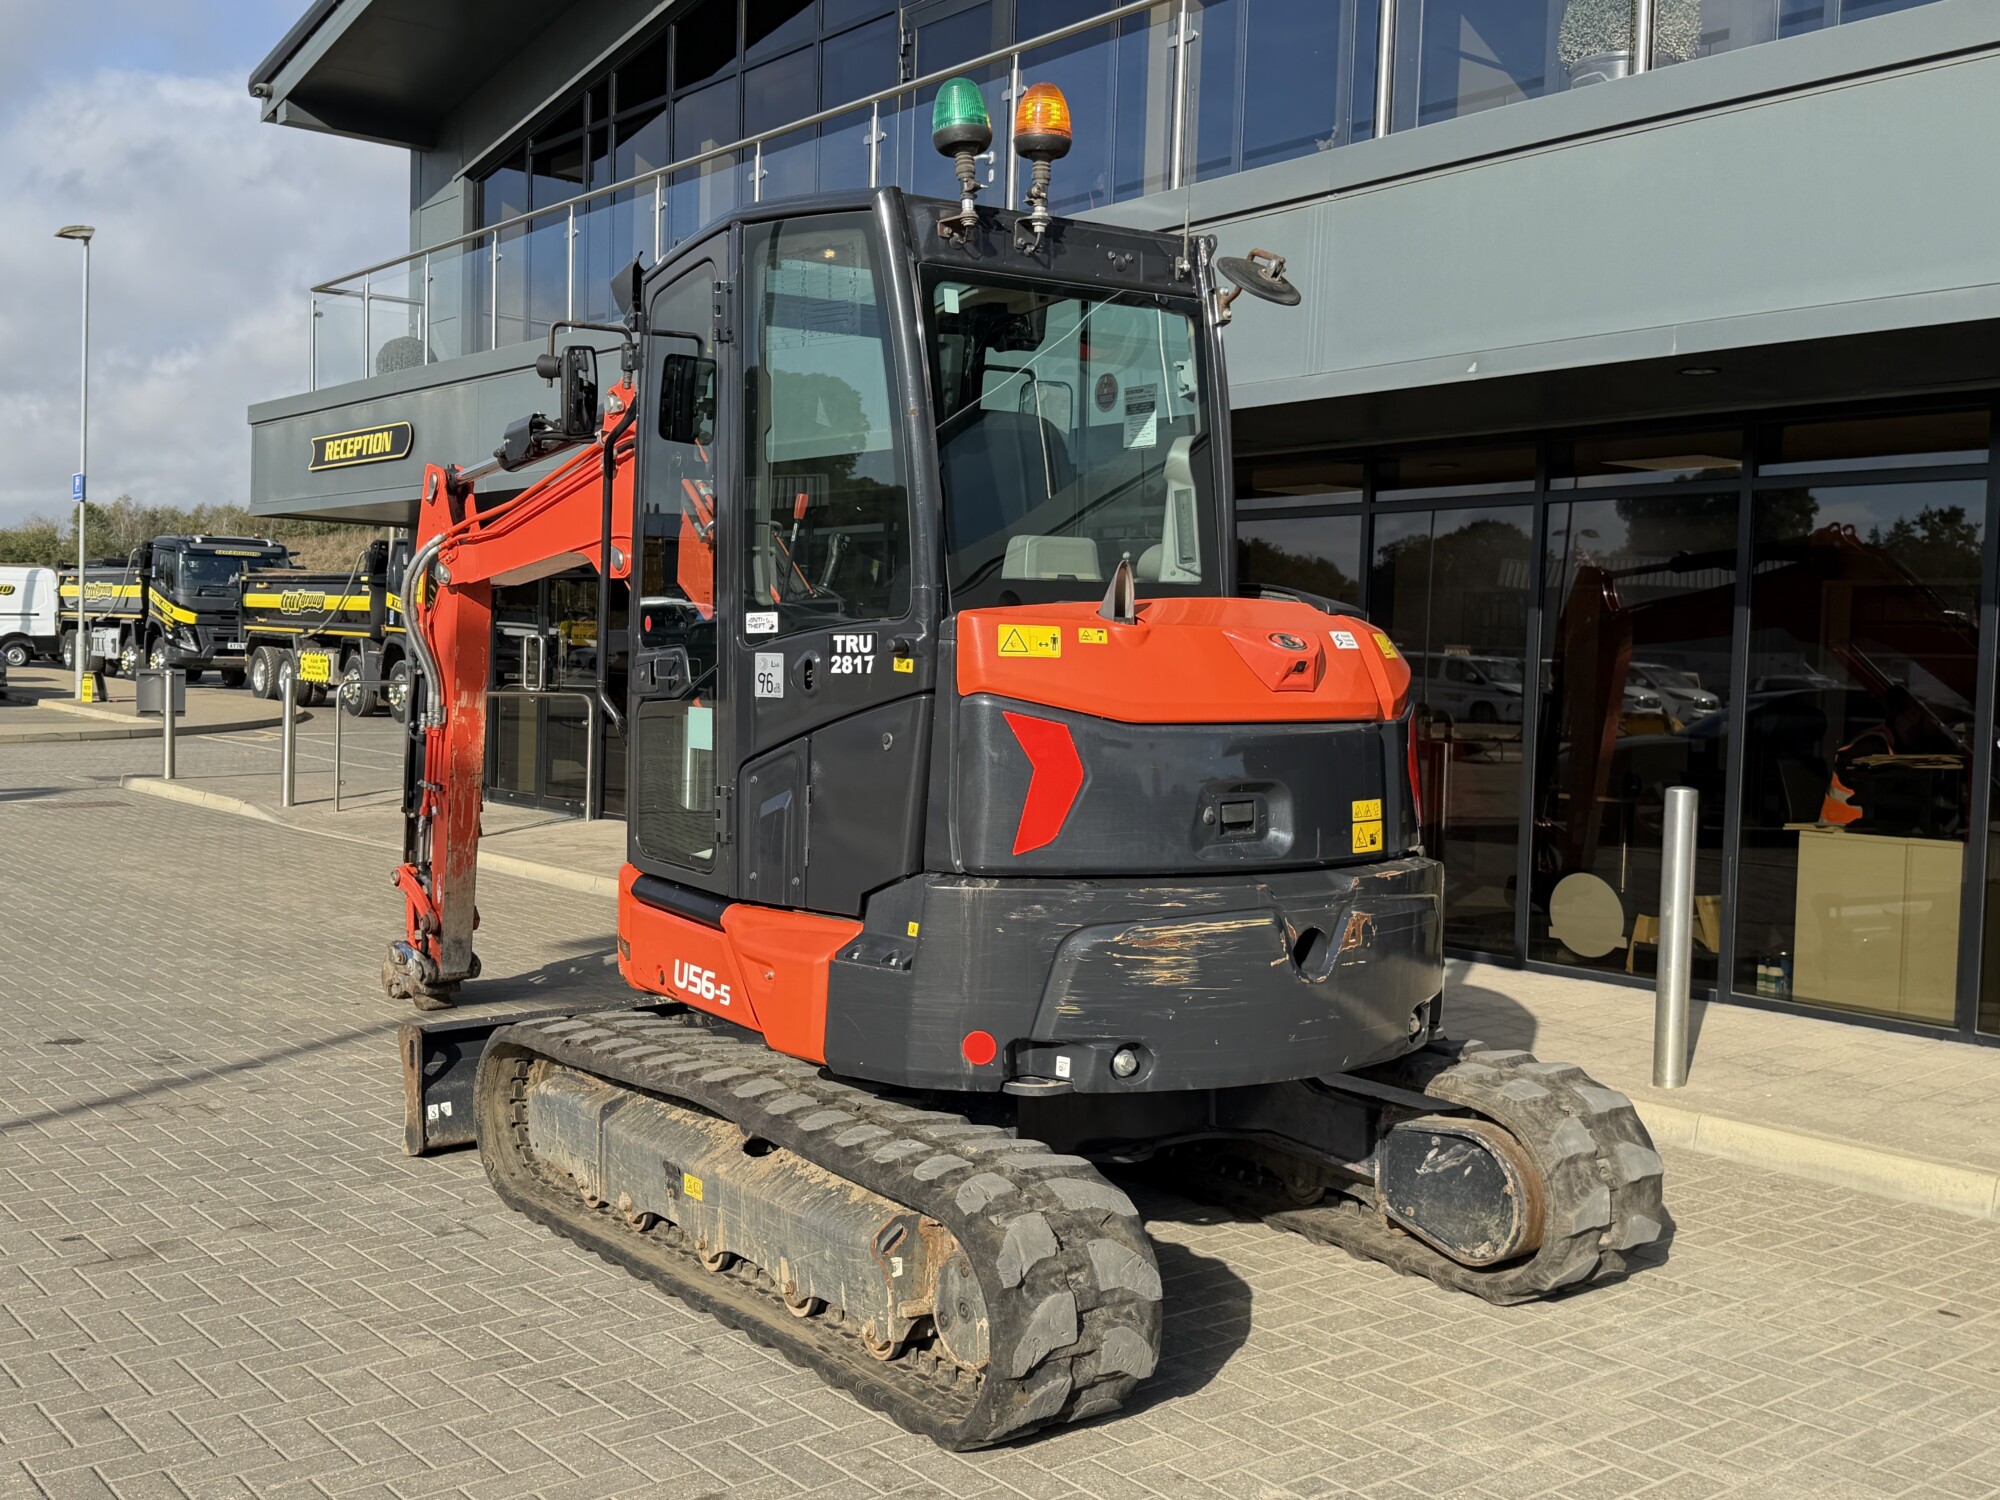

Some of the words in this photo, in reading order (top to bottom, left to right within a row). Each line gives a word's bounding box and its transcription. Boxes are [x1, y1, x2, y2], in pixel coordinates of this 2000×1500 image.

[324, 430, 393, 462] RECEPTION
[833, 634, 872, 653] TRU
[830, 655, 875, 674] 2817
[758, 672, 773, 694] 96
[674, 958, 731, 1006] U56-5
